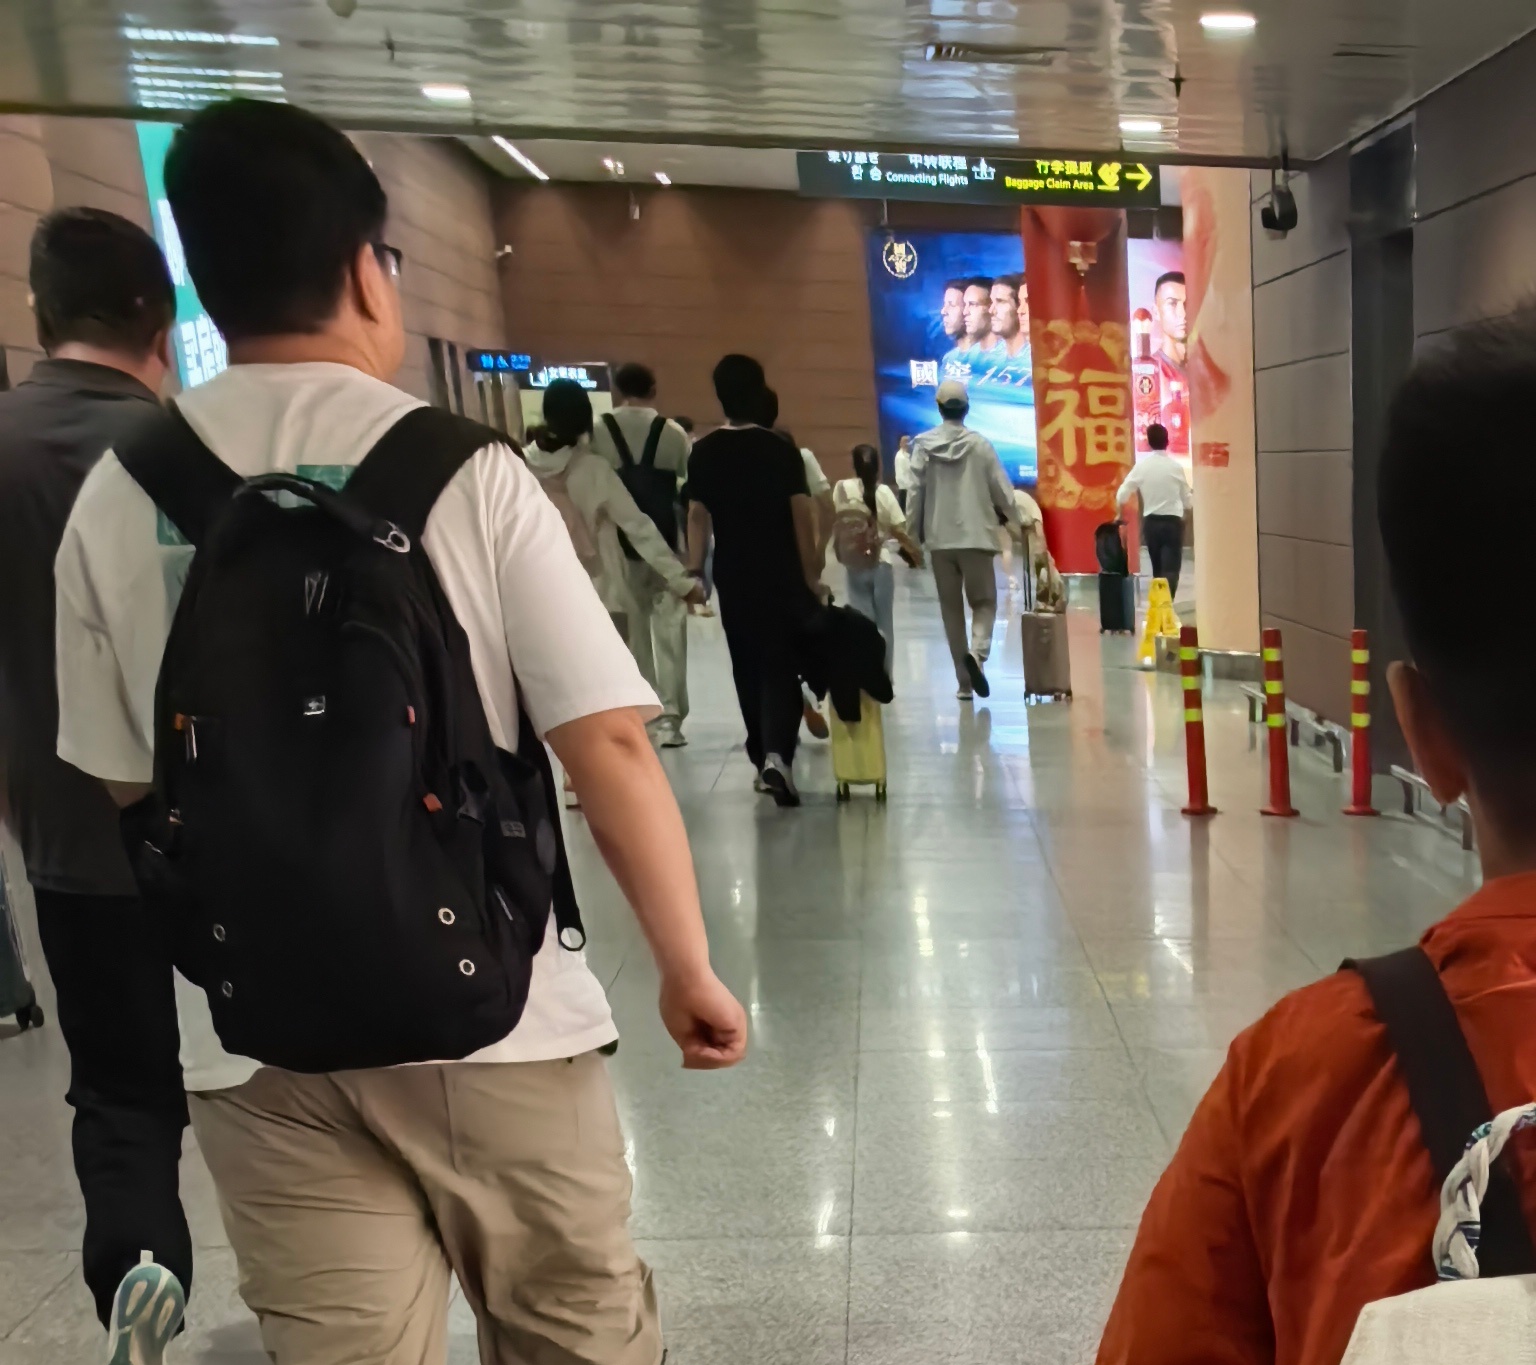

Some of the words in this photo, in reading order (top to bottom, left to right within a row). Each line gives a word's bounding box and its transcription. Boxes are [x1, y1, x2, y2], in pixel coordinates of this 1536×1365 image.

[1036, 159, 1093, 176] 行李提取
[885, 171, 937, 186] Connecting
[938, 173, 969, 187] Flights
[1004, 175, 1045, 190] Baggage
[1046, 177, 1071, 189] Claim
[1072, 178, 1094, 190] Area
[1040, 367, 1132, 467] 福
